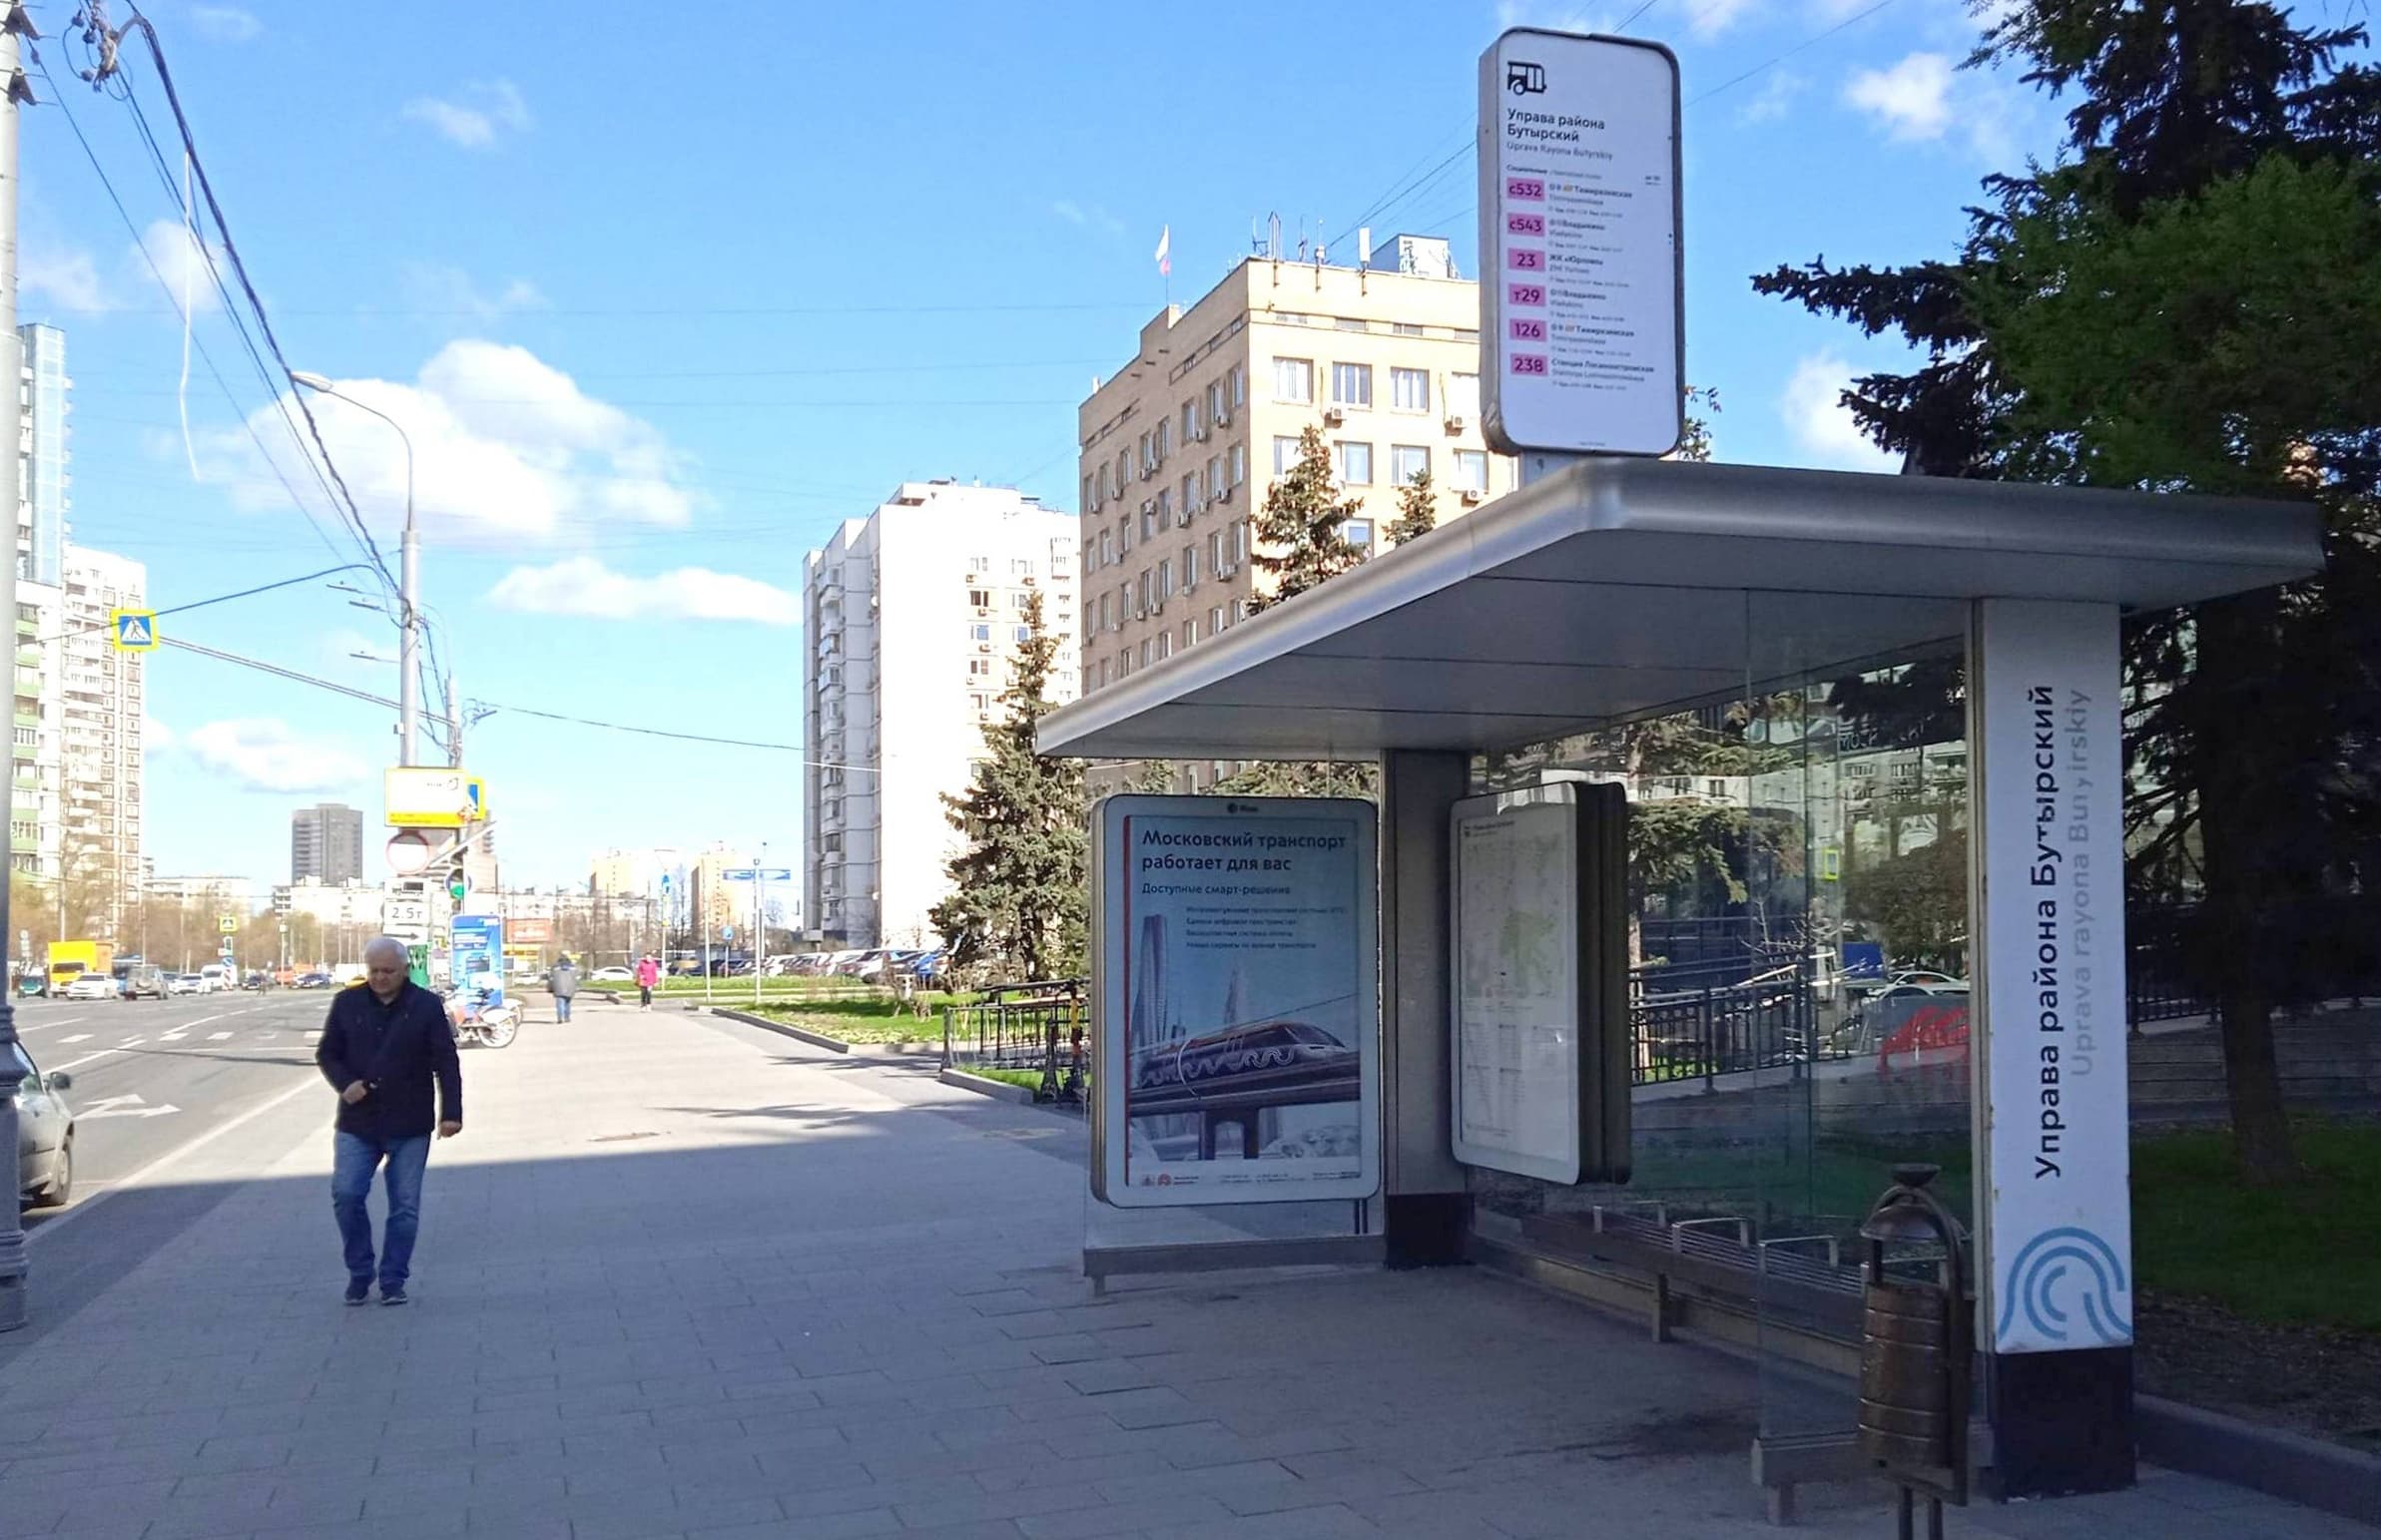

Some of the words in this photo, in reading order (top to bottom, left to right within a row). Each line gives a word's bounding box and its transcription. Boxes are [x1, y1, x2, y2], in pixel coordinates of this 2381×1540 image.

[1507, 108, 1555, 126] Управа
[1558, 115, 1605, 132] района
[1507, 124, 1579, 142] Бутырский
[1508, 184, 1542, 198] с532
[1508, 219, 1542, 233] с543
[1516, 254, 1535, 267] 23
[1515, 322, 1540, 337] 126
[1514, 358, 1543, 372] 238
[2028, 686, 2063, 886] Бутырский
[1142, 830, 1253, 848] Московский
[1258, 835, 1346, 850] транспорт
[1142, 853, 1222, 872] работает
[1227, 858, 1258, 872] для
[1263, 858, 1292, 870] вас
[1142, 883, 1201, 896] Доступные
[1205, 885, 1291, 896] смарт-решения
[2074, 853, 2095, 956] rayona
[2033, 899, 2064, 1031] района
[2072, 966, 2096, 1076] Uprava
[2035, 1045, 2066, 1179] Управа
